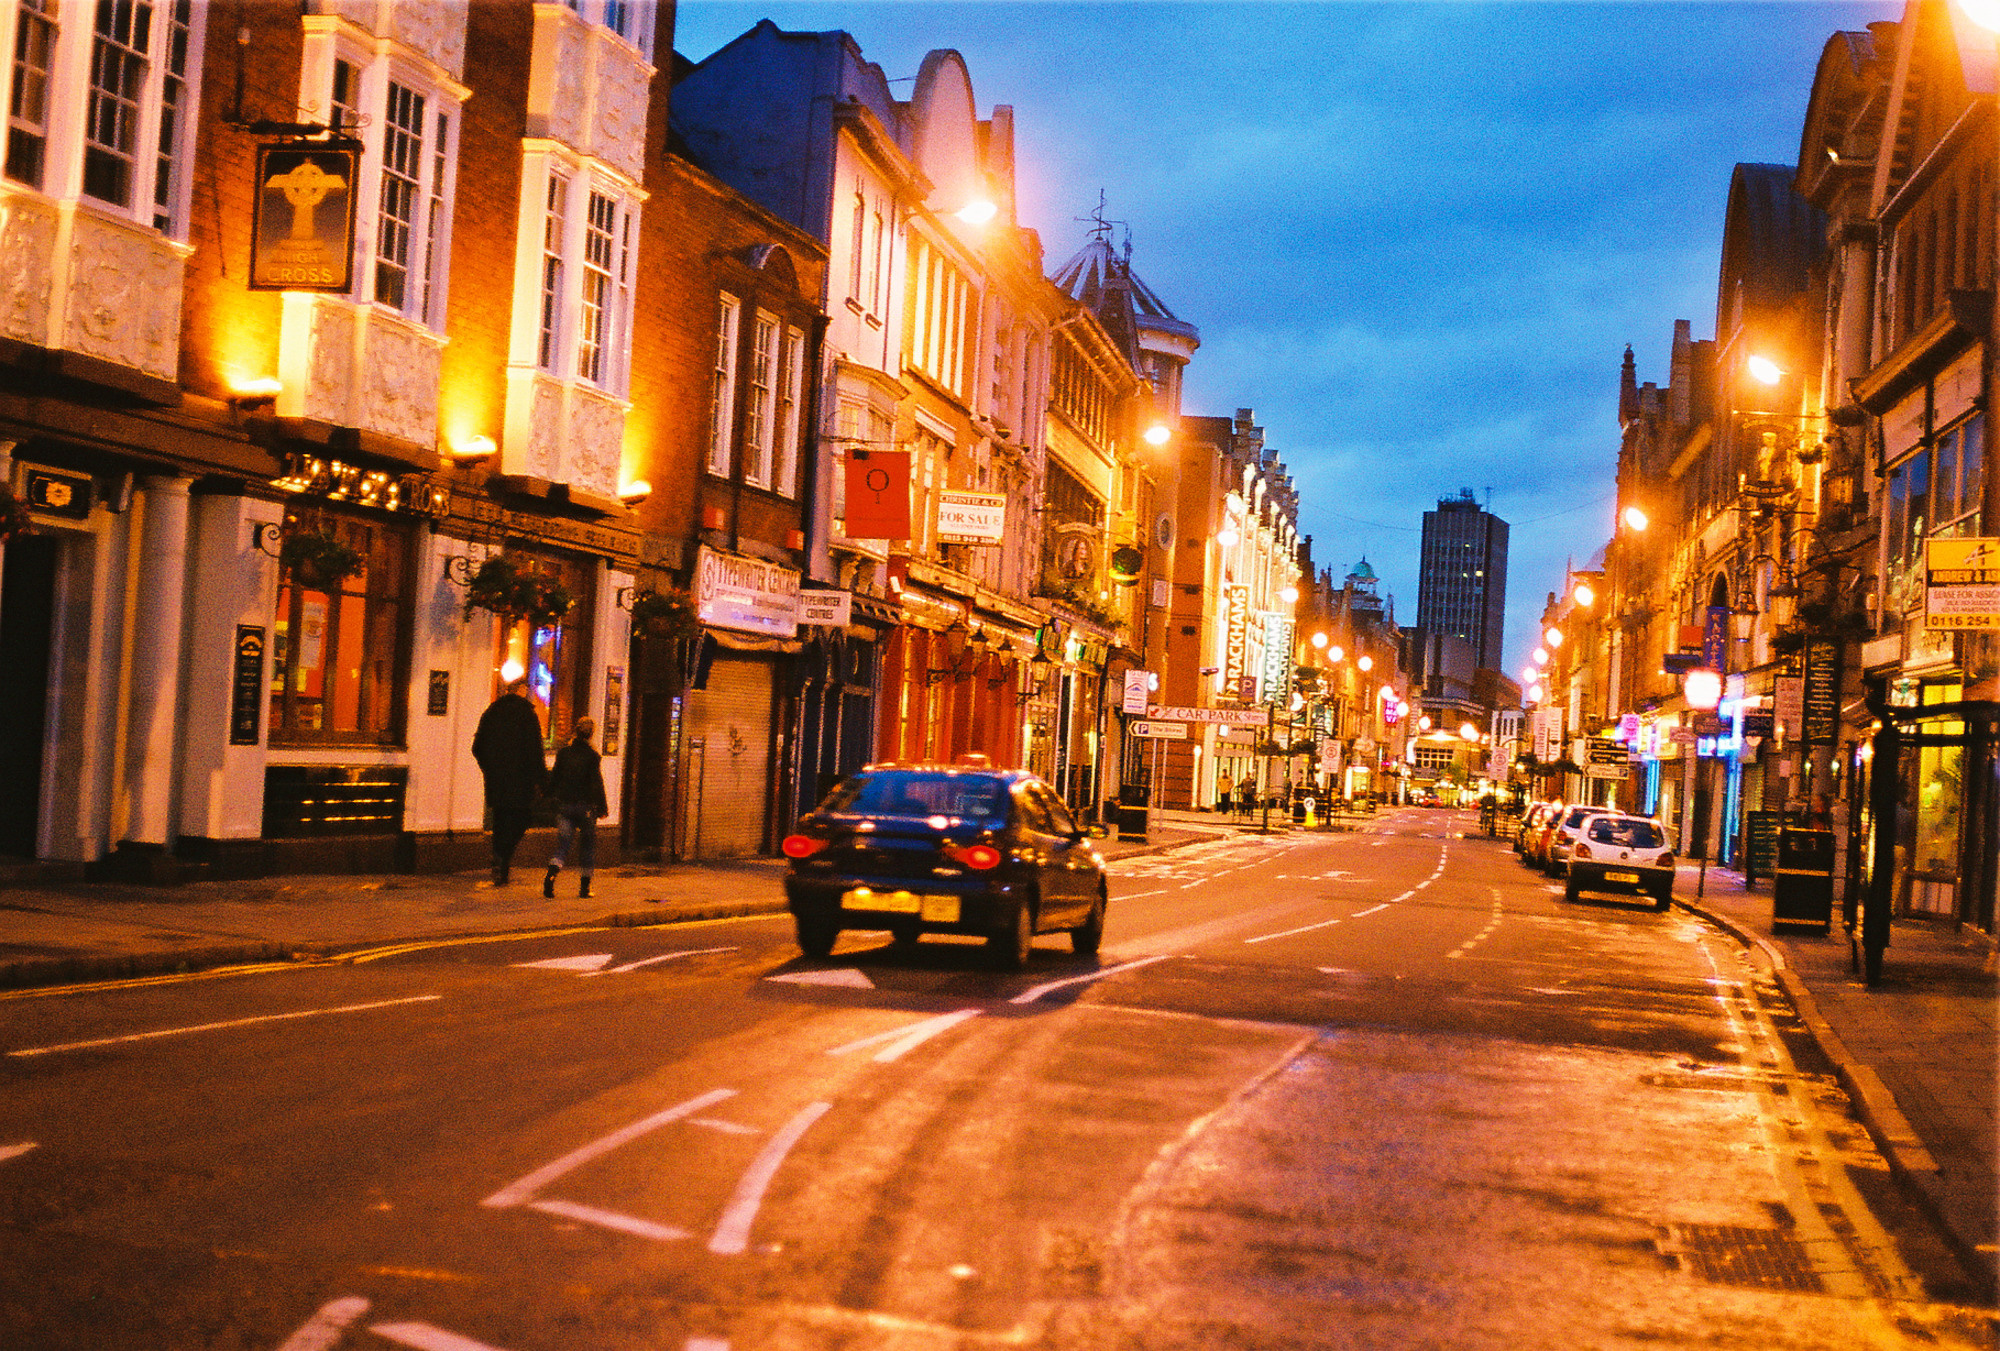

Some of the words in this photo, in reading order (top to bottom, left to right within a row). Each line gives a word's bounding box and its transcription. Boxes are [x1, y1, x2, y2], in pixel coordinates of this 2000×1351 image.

[267, 266, 333, 282] CROSS
[940, 511, 965, 523] FOR
[968, 514, 1001, 527] SALE
[1932, 570, 1972, 582] ANDREW
[806, 608, 834, 620] CENTRES
[1931, 616, 1963, 626] 0116
[1967, 616, 1990, 626] 254
[1228, 587, 1247, 679] RACKHAMS
[1264, 615, 1282, 693] RACKHAMS
[1176, 709, 1204, 720] CAR
[1208, 710, 1243, 723] PARK
